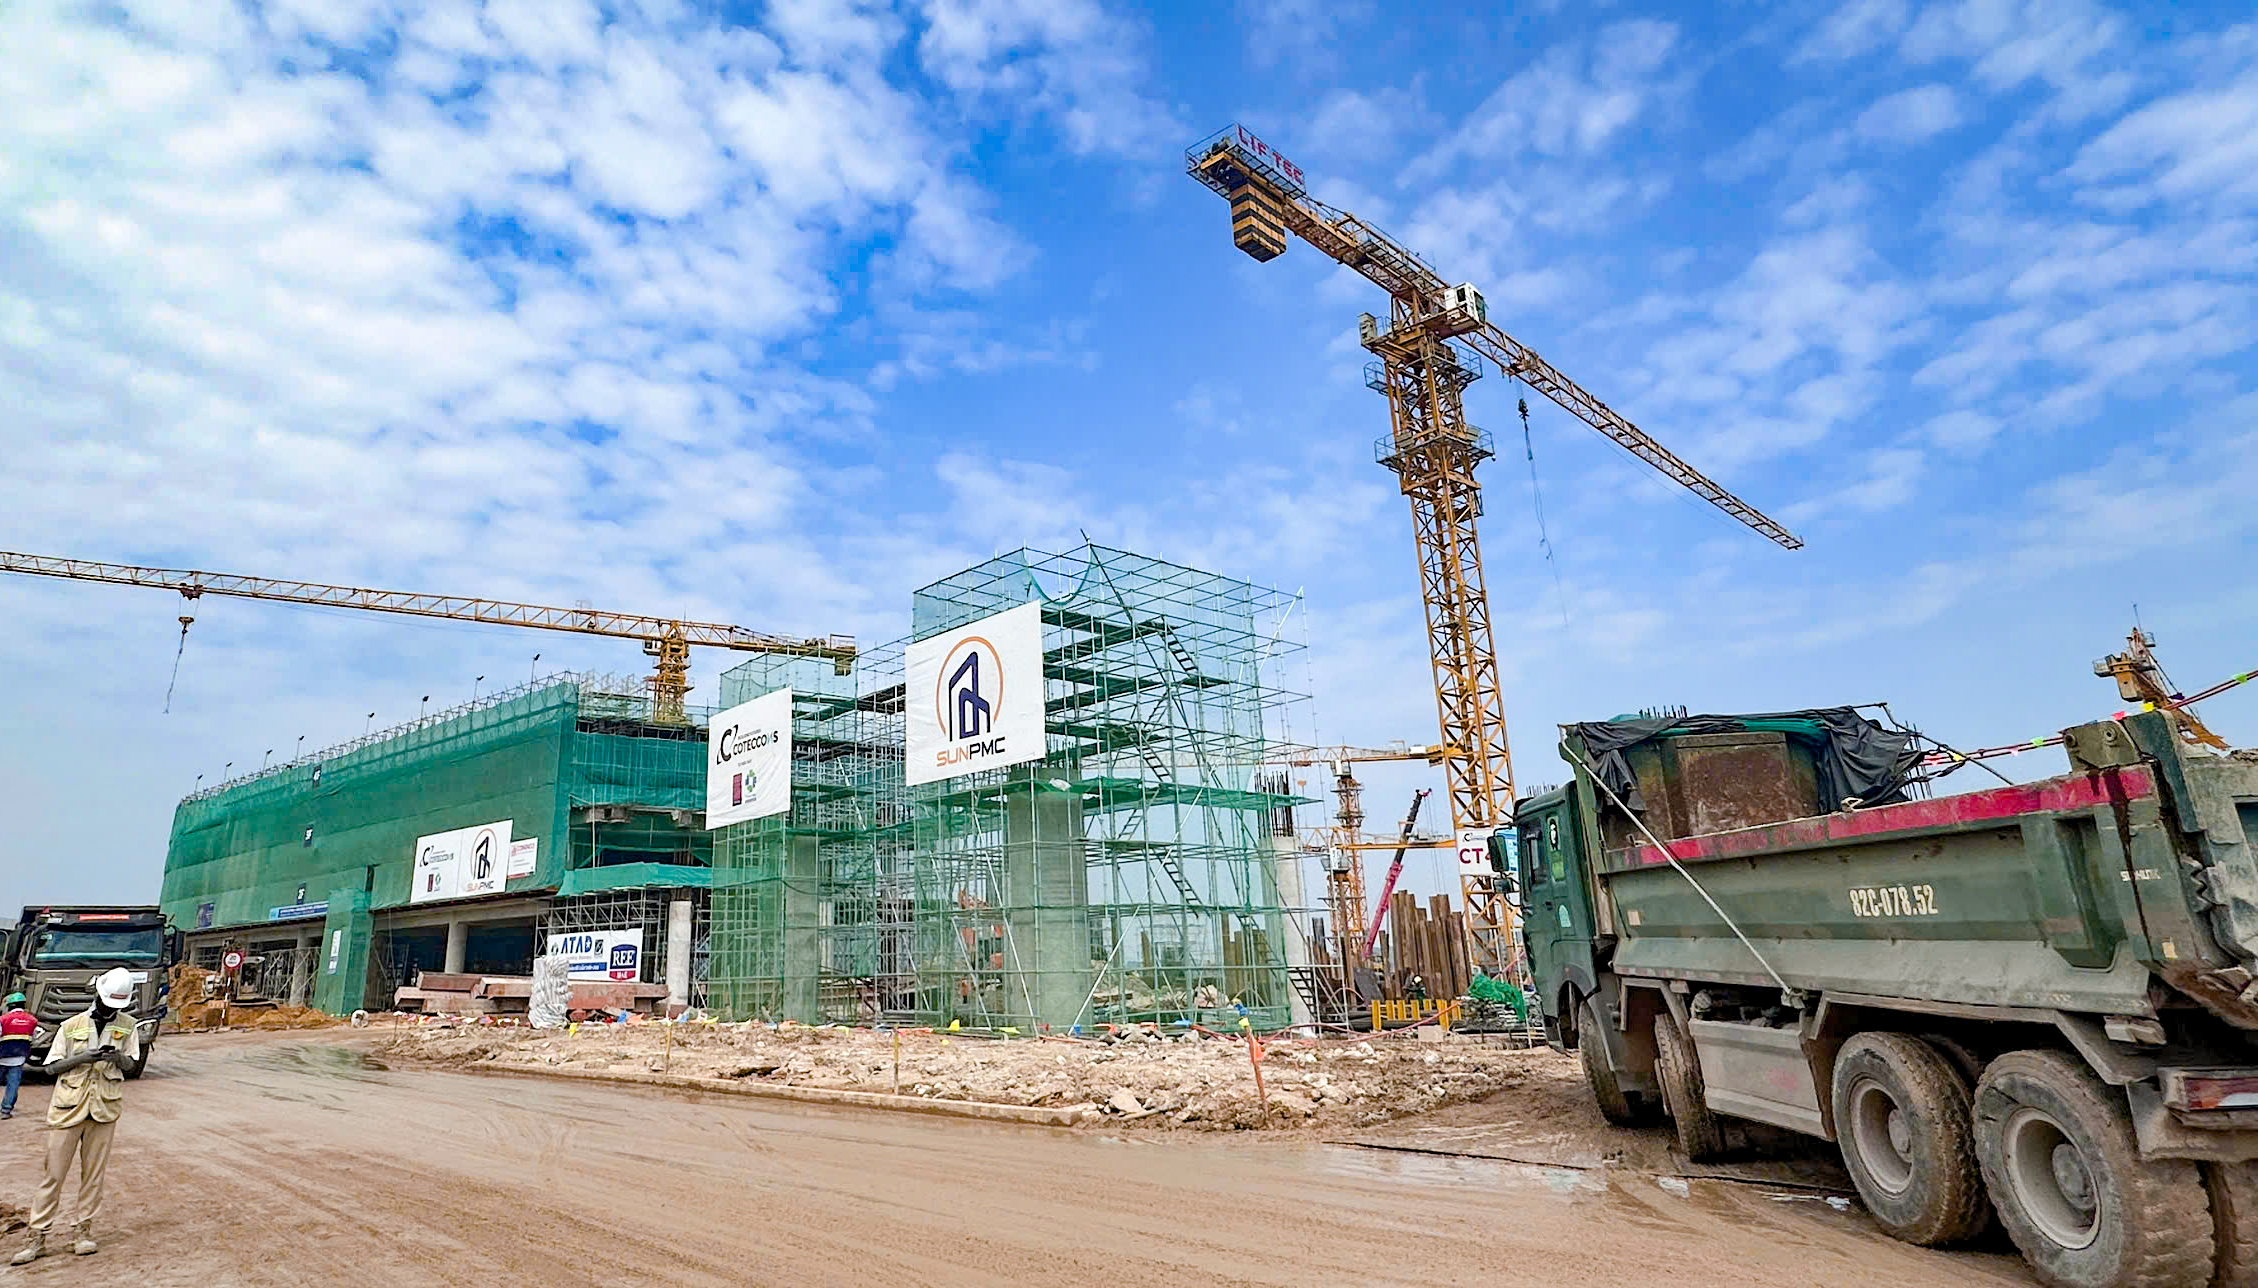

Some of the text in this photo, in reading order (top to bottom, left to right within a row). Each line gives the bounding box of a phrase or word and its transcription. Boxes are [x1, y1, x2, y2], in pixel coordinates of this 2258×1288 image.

[936, 736, 1006, 767] SUNPMC
[1459, 848, 1490, 864] CT
[1849, 884, 1939, 917] 82C-078.52
[560, 935, 593, 954] ATAD
[612, 950, 636, 967] REE
